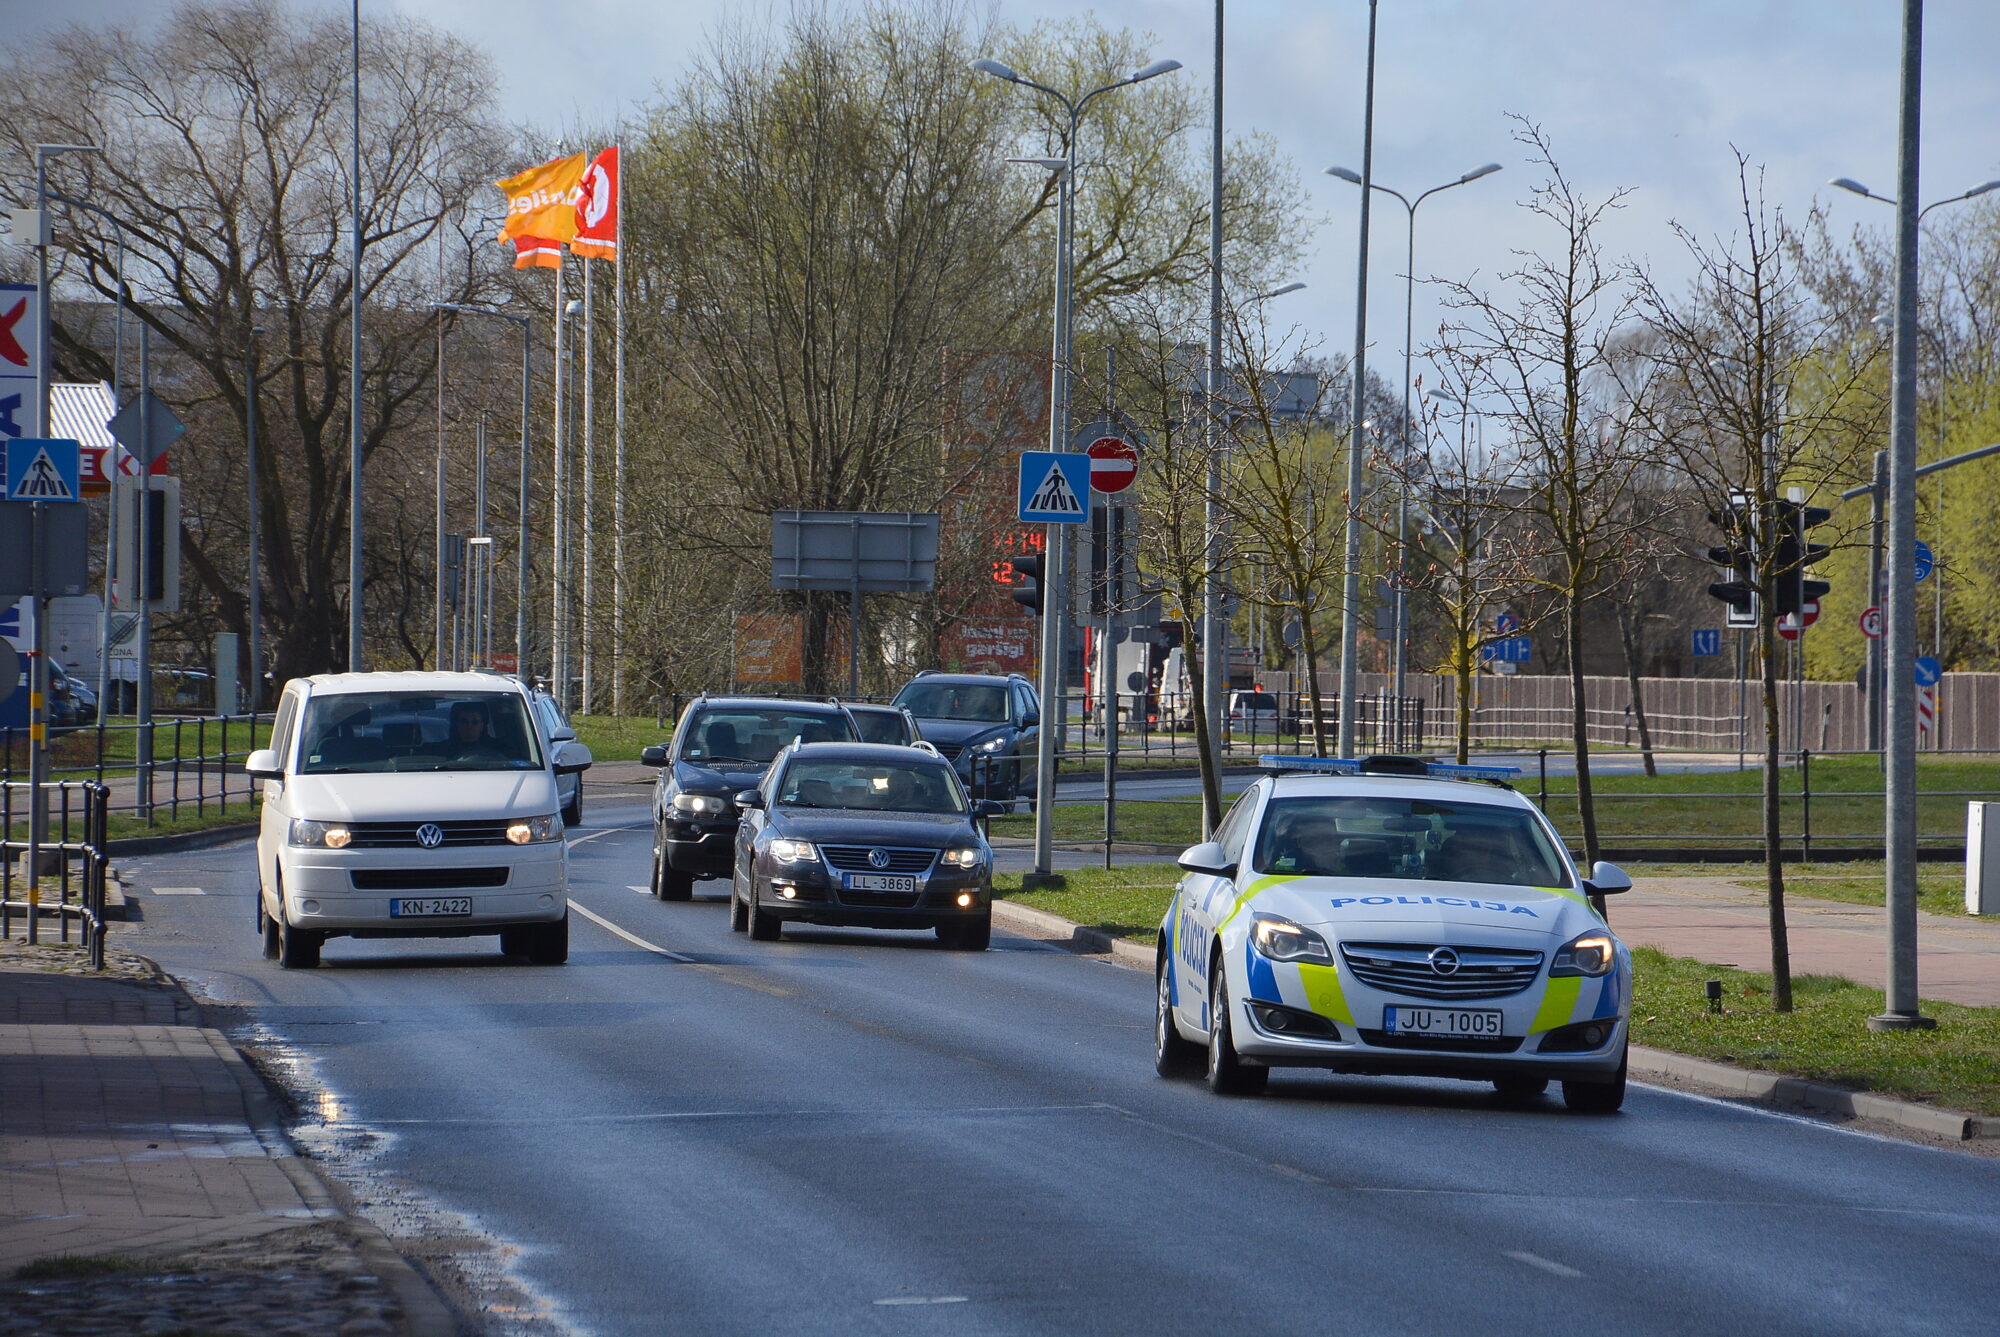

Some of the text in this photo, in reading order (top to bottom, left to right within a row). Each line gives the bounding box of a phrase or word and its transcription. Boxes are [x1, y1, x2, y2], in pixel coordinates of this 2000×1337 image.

[852, 876, 912, 891] LL-3869
[402, 900, 469, 914] KN-2422
[1330, 896, 1540, 919] POLICIJA
[1401, 1011, 1498, 1033] JU-1005
